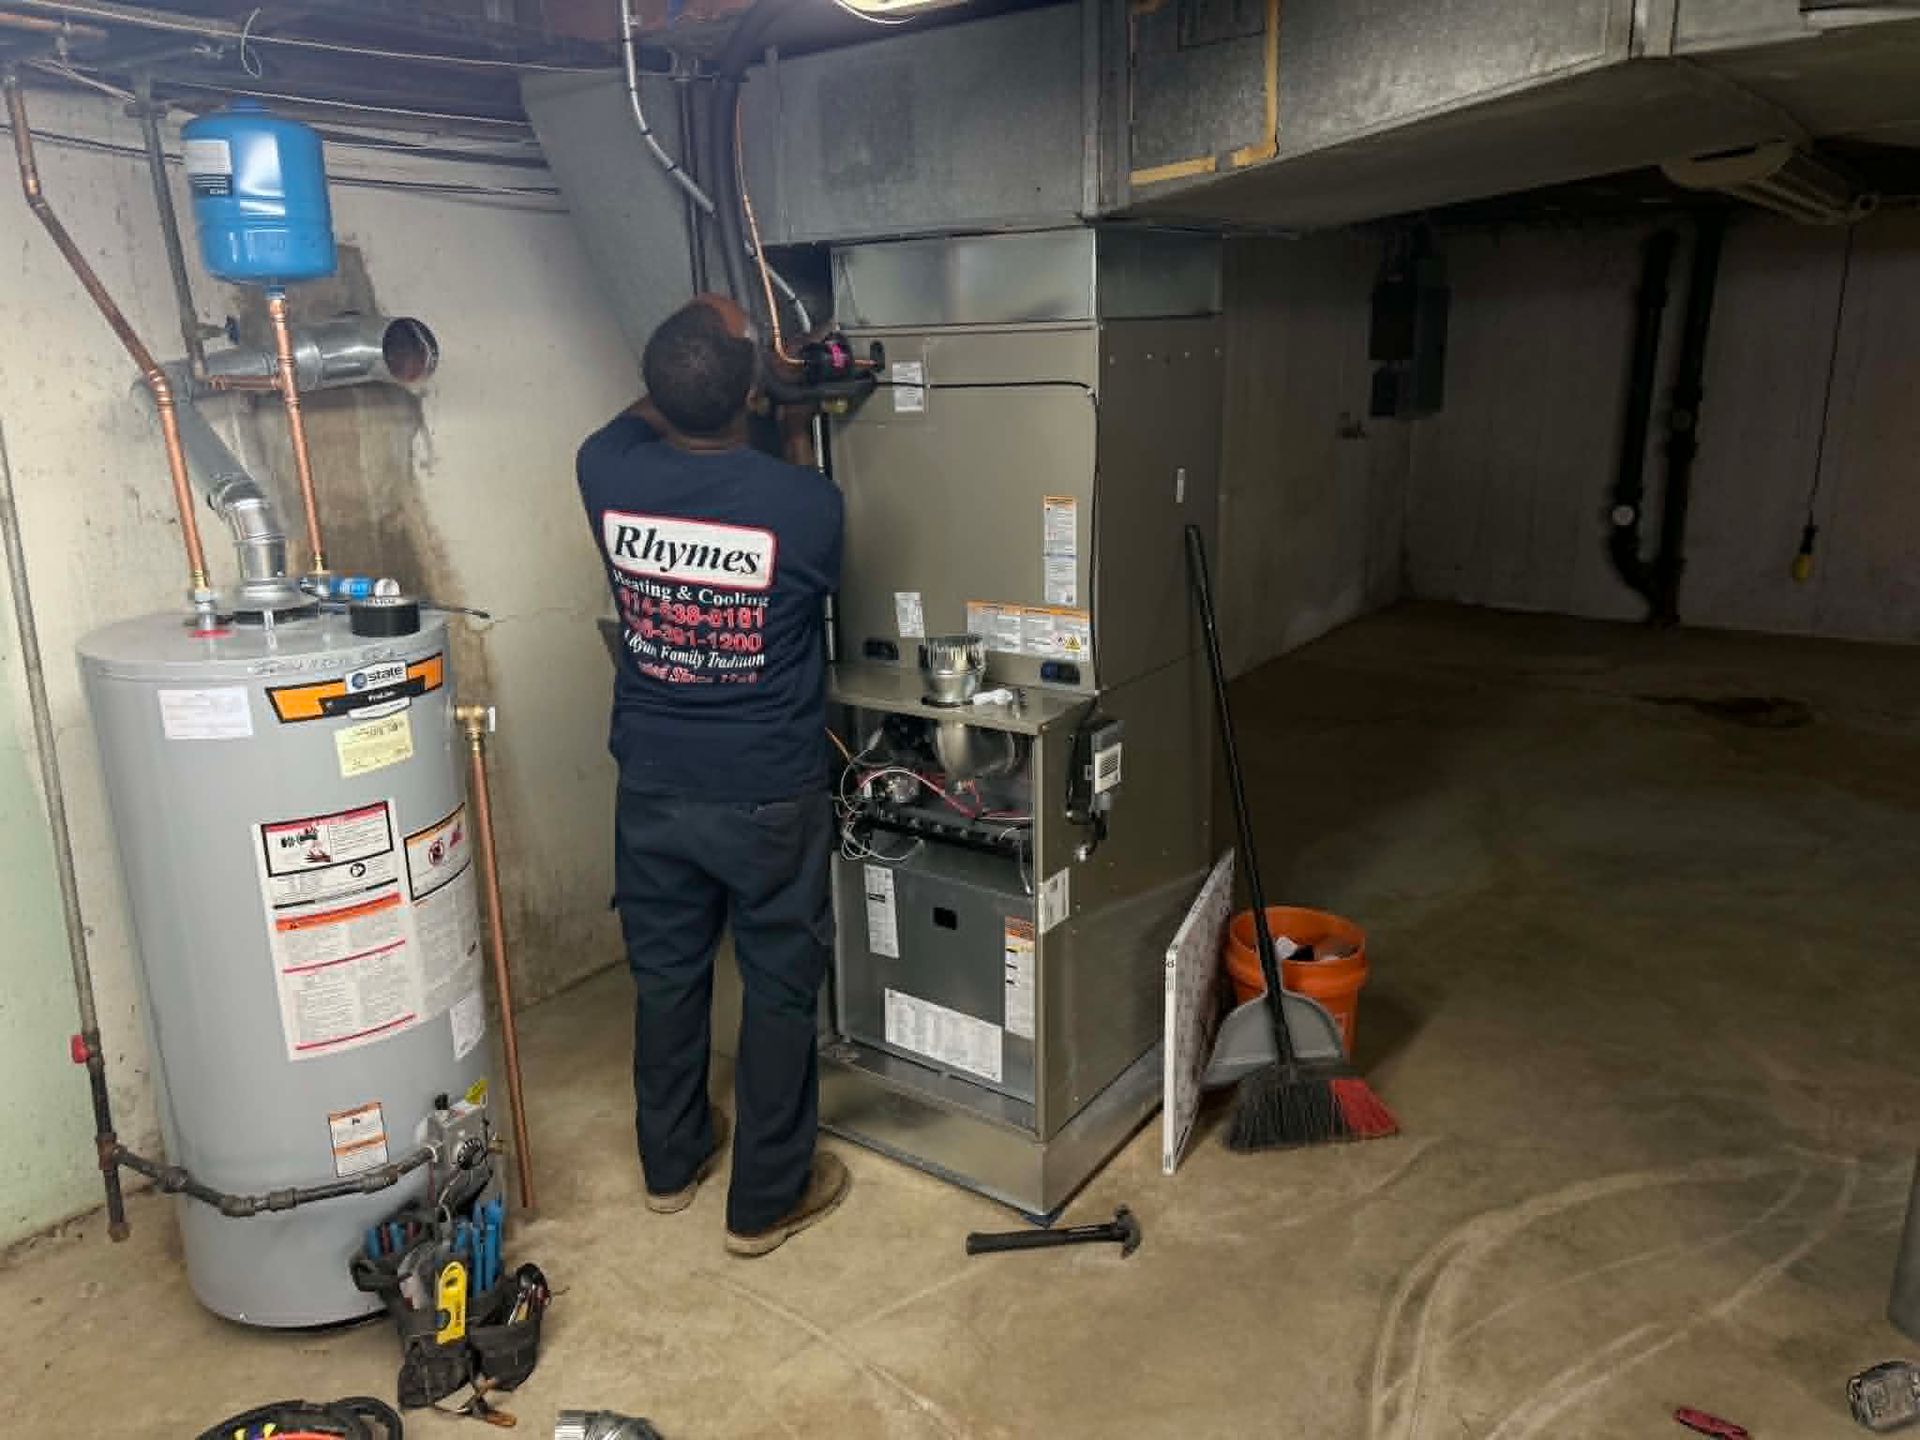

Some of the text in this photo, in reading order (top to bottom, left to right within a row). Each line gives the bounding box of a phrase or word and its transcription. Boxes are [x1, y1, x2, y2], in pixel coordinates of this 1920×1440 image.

[615, 524, 761, 575] Rhymes
[676, 585, 693, 600] &
[698, 589, 769, 608] Cooling
[661, 646, 705, 669] Family
[368, 667, 403, 682] state
